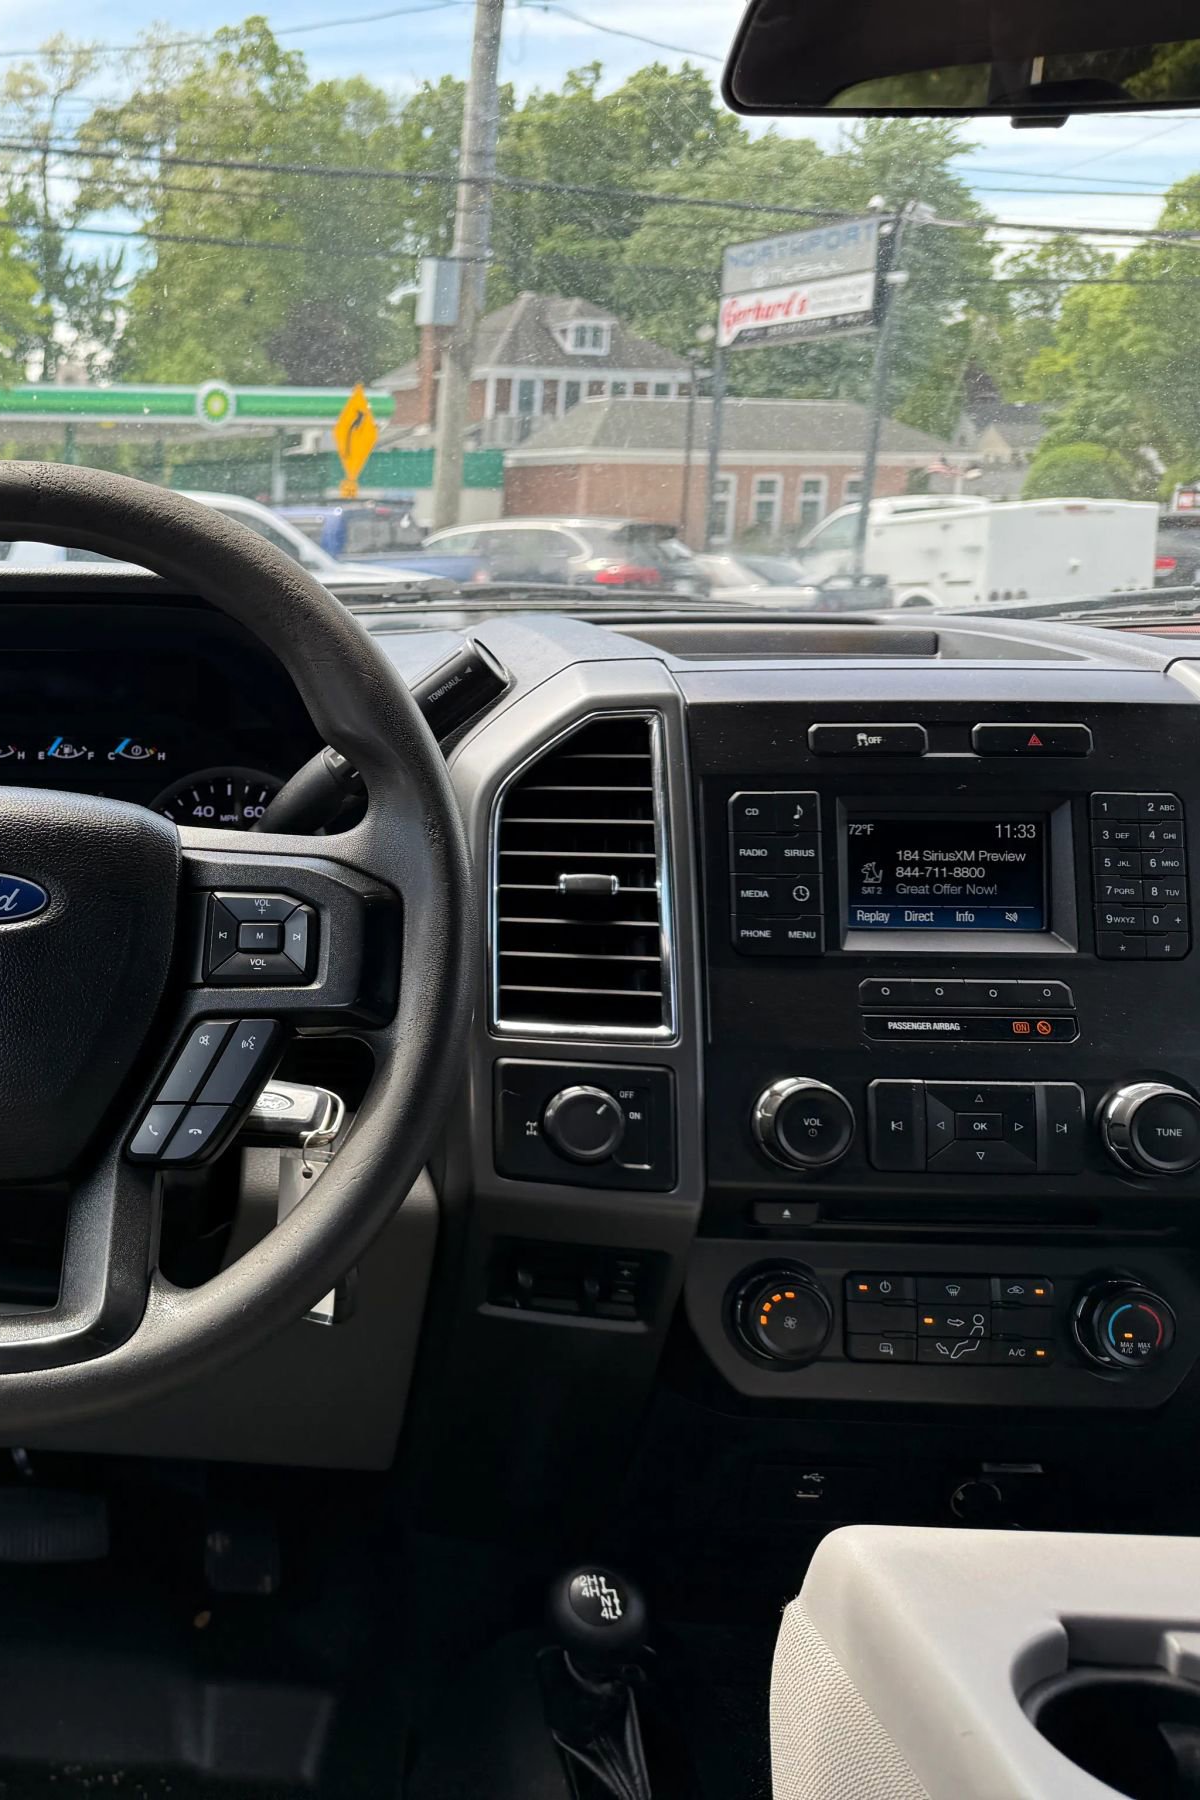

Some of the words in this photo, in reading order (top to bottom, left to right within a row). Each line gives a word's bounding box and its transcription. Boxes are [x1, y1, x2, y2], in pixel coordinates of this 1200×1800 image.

[428, 676, 462, 703] TOW/HAUL
[868, 736, 882, 744] OFF
[18, 751, 25, 760] H
[38, 752, 45, 760] E
[88, 752, 94, 760] F
[108, 752, 115, 760] C
[158, 752, 165, 760] H
[192, 806, 215, 817] 40
[1102, 803, 1108, 811] 1
[1148, 803, 1154, 812] 2
[243, 806, 265, 818] 60
[745, 808, 759, 816] CD
[995, 824, 1036, 839] 11:33
[1103, 831, 1109, 839] 3
[1149, 831, 1155, 839] 4
[739, 849, 767, 857] RADIO
[784, 849, 815, 857] SIRIUS
[896, 850, 919, 861] 184
[922, 850, 975, 861] SiriusXM
[979, 851, 1026, 862] Preview
[1104, 858, 1111, 867] 5
[1150, 859, 1157, 867] 6
[896, 867, 986, 878] 844-711-8800
[741, 890, 770, 898] MEDIA
[896, 884, 929, 895] Great
[933, 884, 963, 895] Offer
[966, 884, 998, 895] Now!
[1106, 886, 1112, 895] 7
[1152, 887, 1158, 896] 8
[254, 899, 270, 907] VOL
[856, 910, 890, 924] Replay
[905, 910, 934, 922] Direct
[956, 911, 975, 922] Info
[1106, 914, 1113, 923] 9
[1153, 916, 1159, 924] 0
[740, 930, 772, 938] PHONE
[788, 931, 816, 939] MENU
[888, 1022, 932, 1030] PASSENGER
[933, 1022, 960, 1031] AIRBAG
[619, 1091, 634, 1099] OFF
[629, 1112, 641, 1120] ON
[803, 1118, 823, 1126] VOL
[973, 1122, 987, 1130] OK
[1156, 1128, 1183, 1137] TUNE
[1008, 1348, 1026, 1357] A/C
[580, 1575, 598, 1586] 2H
[582, 1585, 600, 1598] 4H
[600, 1595, 612, 1607] N
[601, 1607, 618, 1619] 4L
